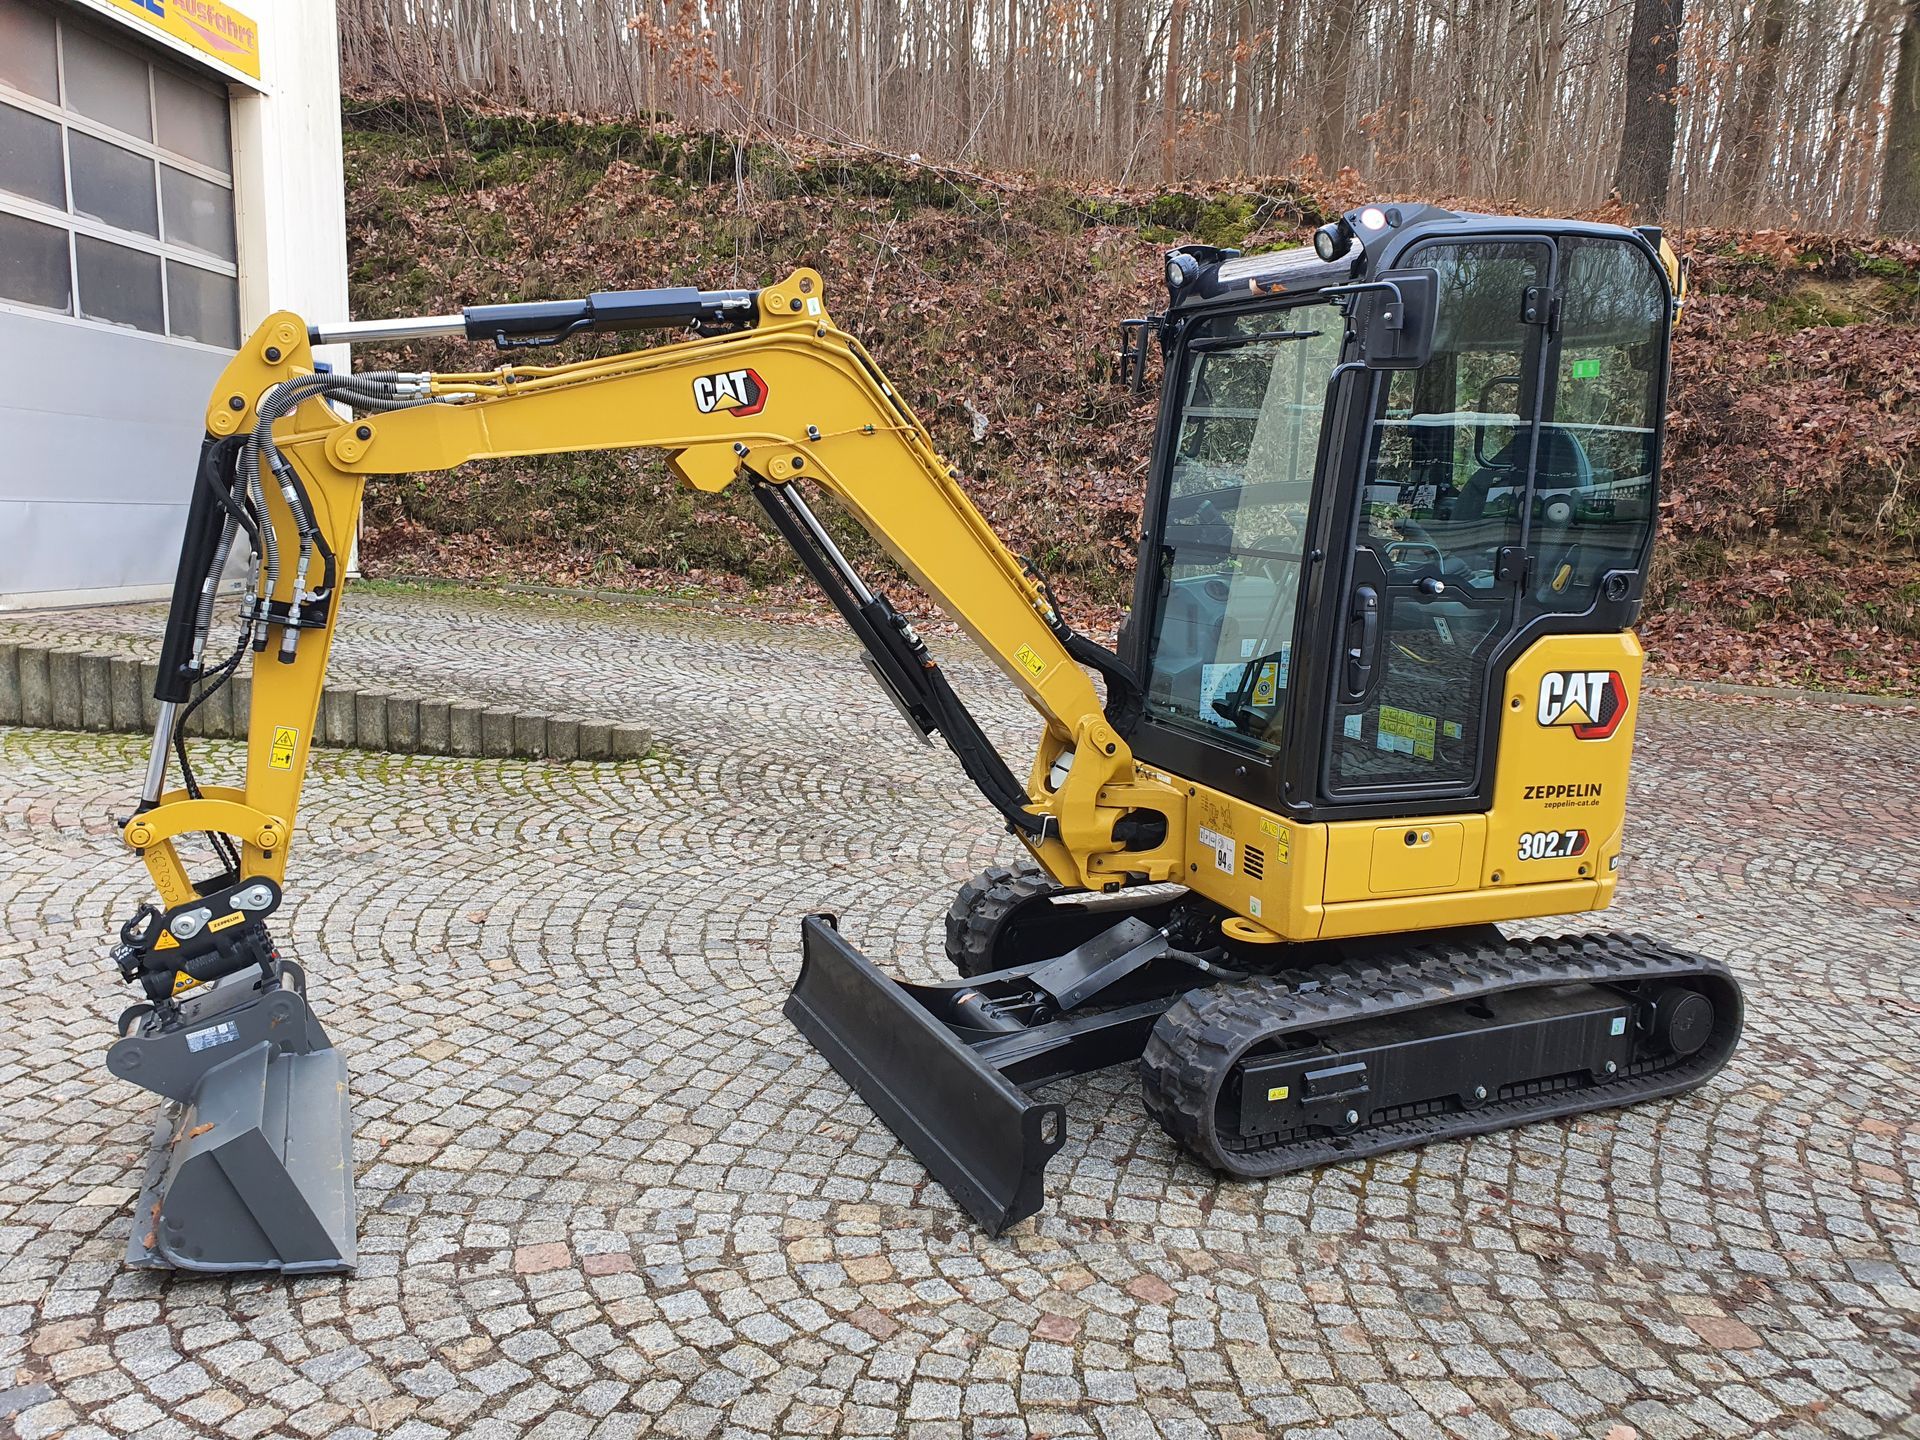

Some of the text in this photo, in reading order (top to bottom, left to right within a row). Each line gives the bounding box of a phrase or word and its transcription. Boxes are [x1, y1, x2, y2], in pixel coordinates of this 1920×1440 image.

[693, 370, 749, 413] CAT
[1537, 672, 1610, 726] CAT
[1523, 783, 1602, 800] ZEPPELIN
[1544, 799, 1600, 809] zeppelin-cat.de
[1518, 831, 1578, 860] 302.7
[1217, 849, 1227, 868] 94
